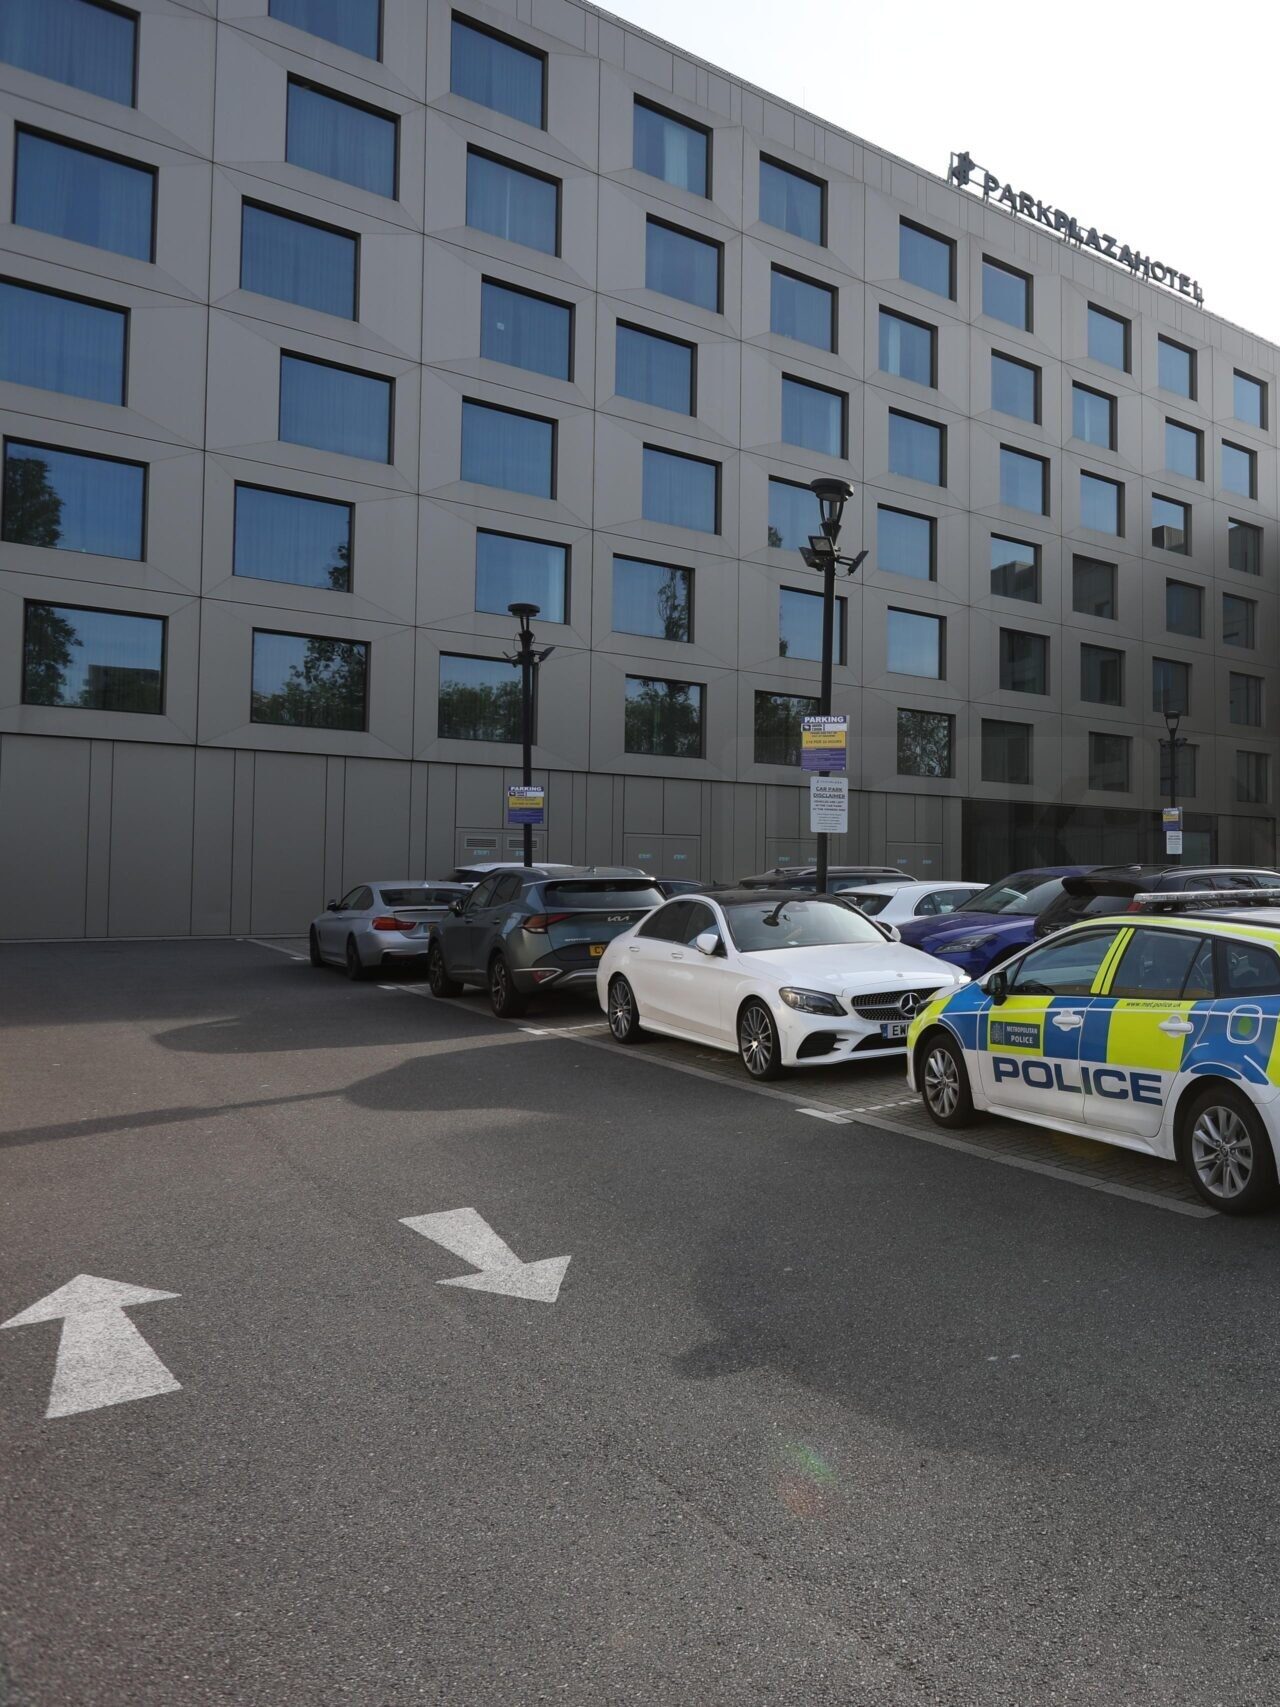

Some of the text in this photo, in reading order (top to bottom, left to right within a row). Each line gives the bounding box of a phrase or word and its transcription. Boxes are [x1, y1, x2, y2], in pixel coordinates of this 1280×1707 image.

[1126, 1001, 1182, 1009] www.met.police.uk
[1006, 1025, 1038, 1035] METROPOLITAN
[1010, 1035, 1033, 1044] POLICE
[992, 1056, 1163, 1107] POLICE
